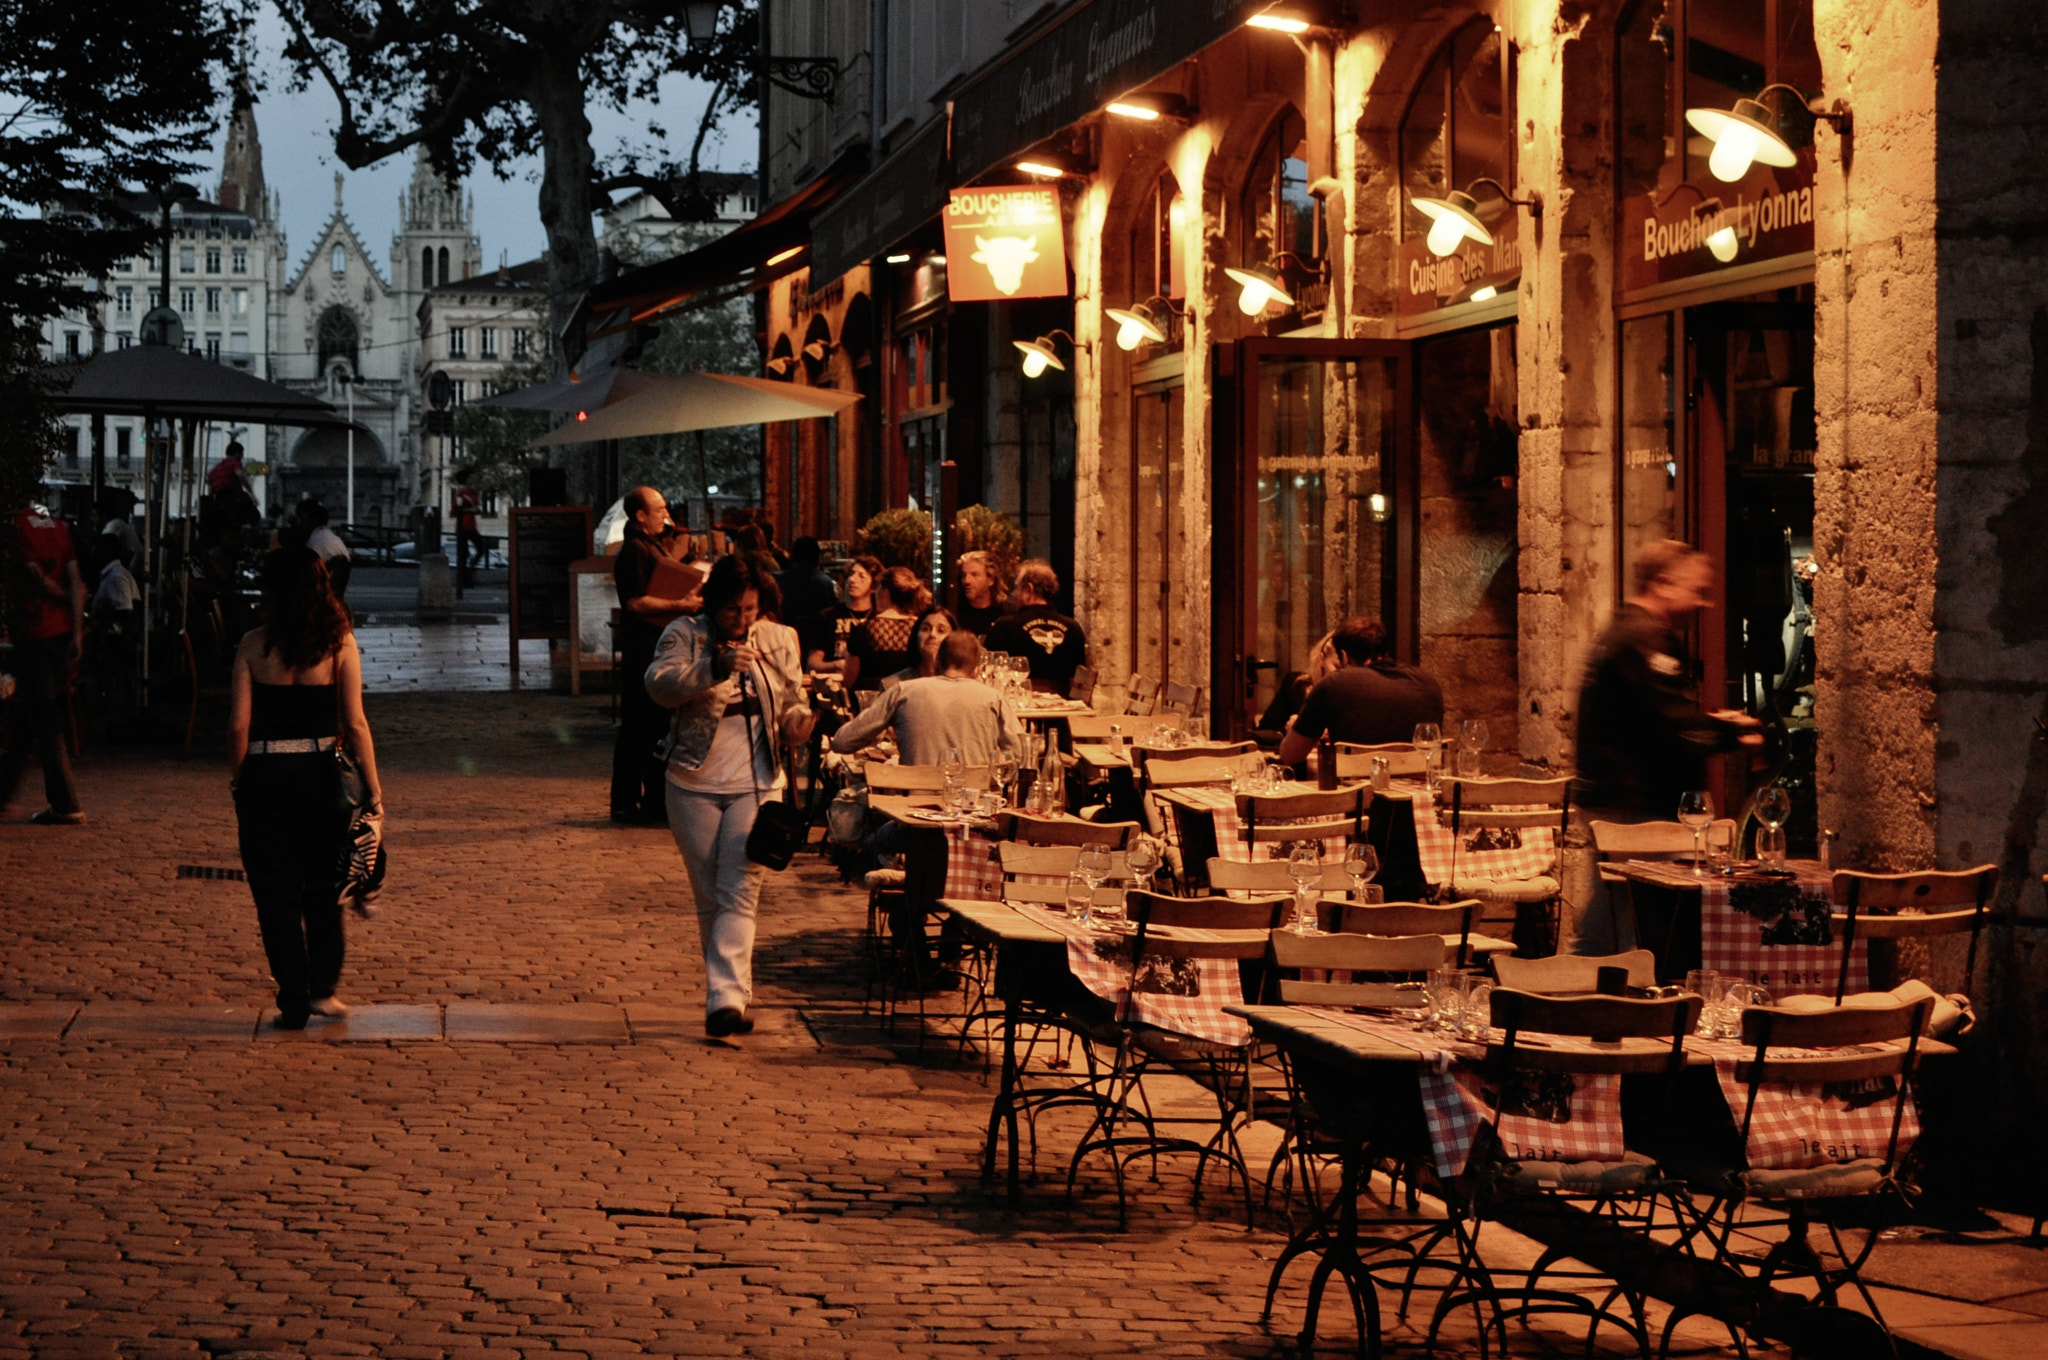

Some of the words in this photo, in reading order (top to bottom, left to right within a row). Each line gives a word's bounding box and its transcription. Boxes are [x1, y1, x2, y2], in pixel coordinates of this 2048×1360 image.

[949, 191, 1054, 216] BOUCHERIE
[1410, 256, 1455, 296] Cuisine
[1461, 245, 1485, 282] des
[1753, 443, 1768, 465] la
[1462, 871, 1479, 880] le
[1488, 867, 1520, 878] lait
[977, 879, 993, 892] le
[1750, 969, 1770, 986] le
[1783, 970, 1822, 984] lait
[1511, 1142, 1563, 1161] lait
[1799, 1139, 1821, 1155] le
